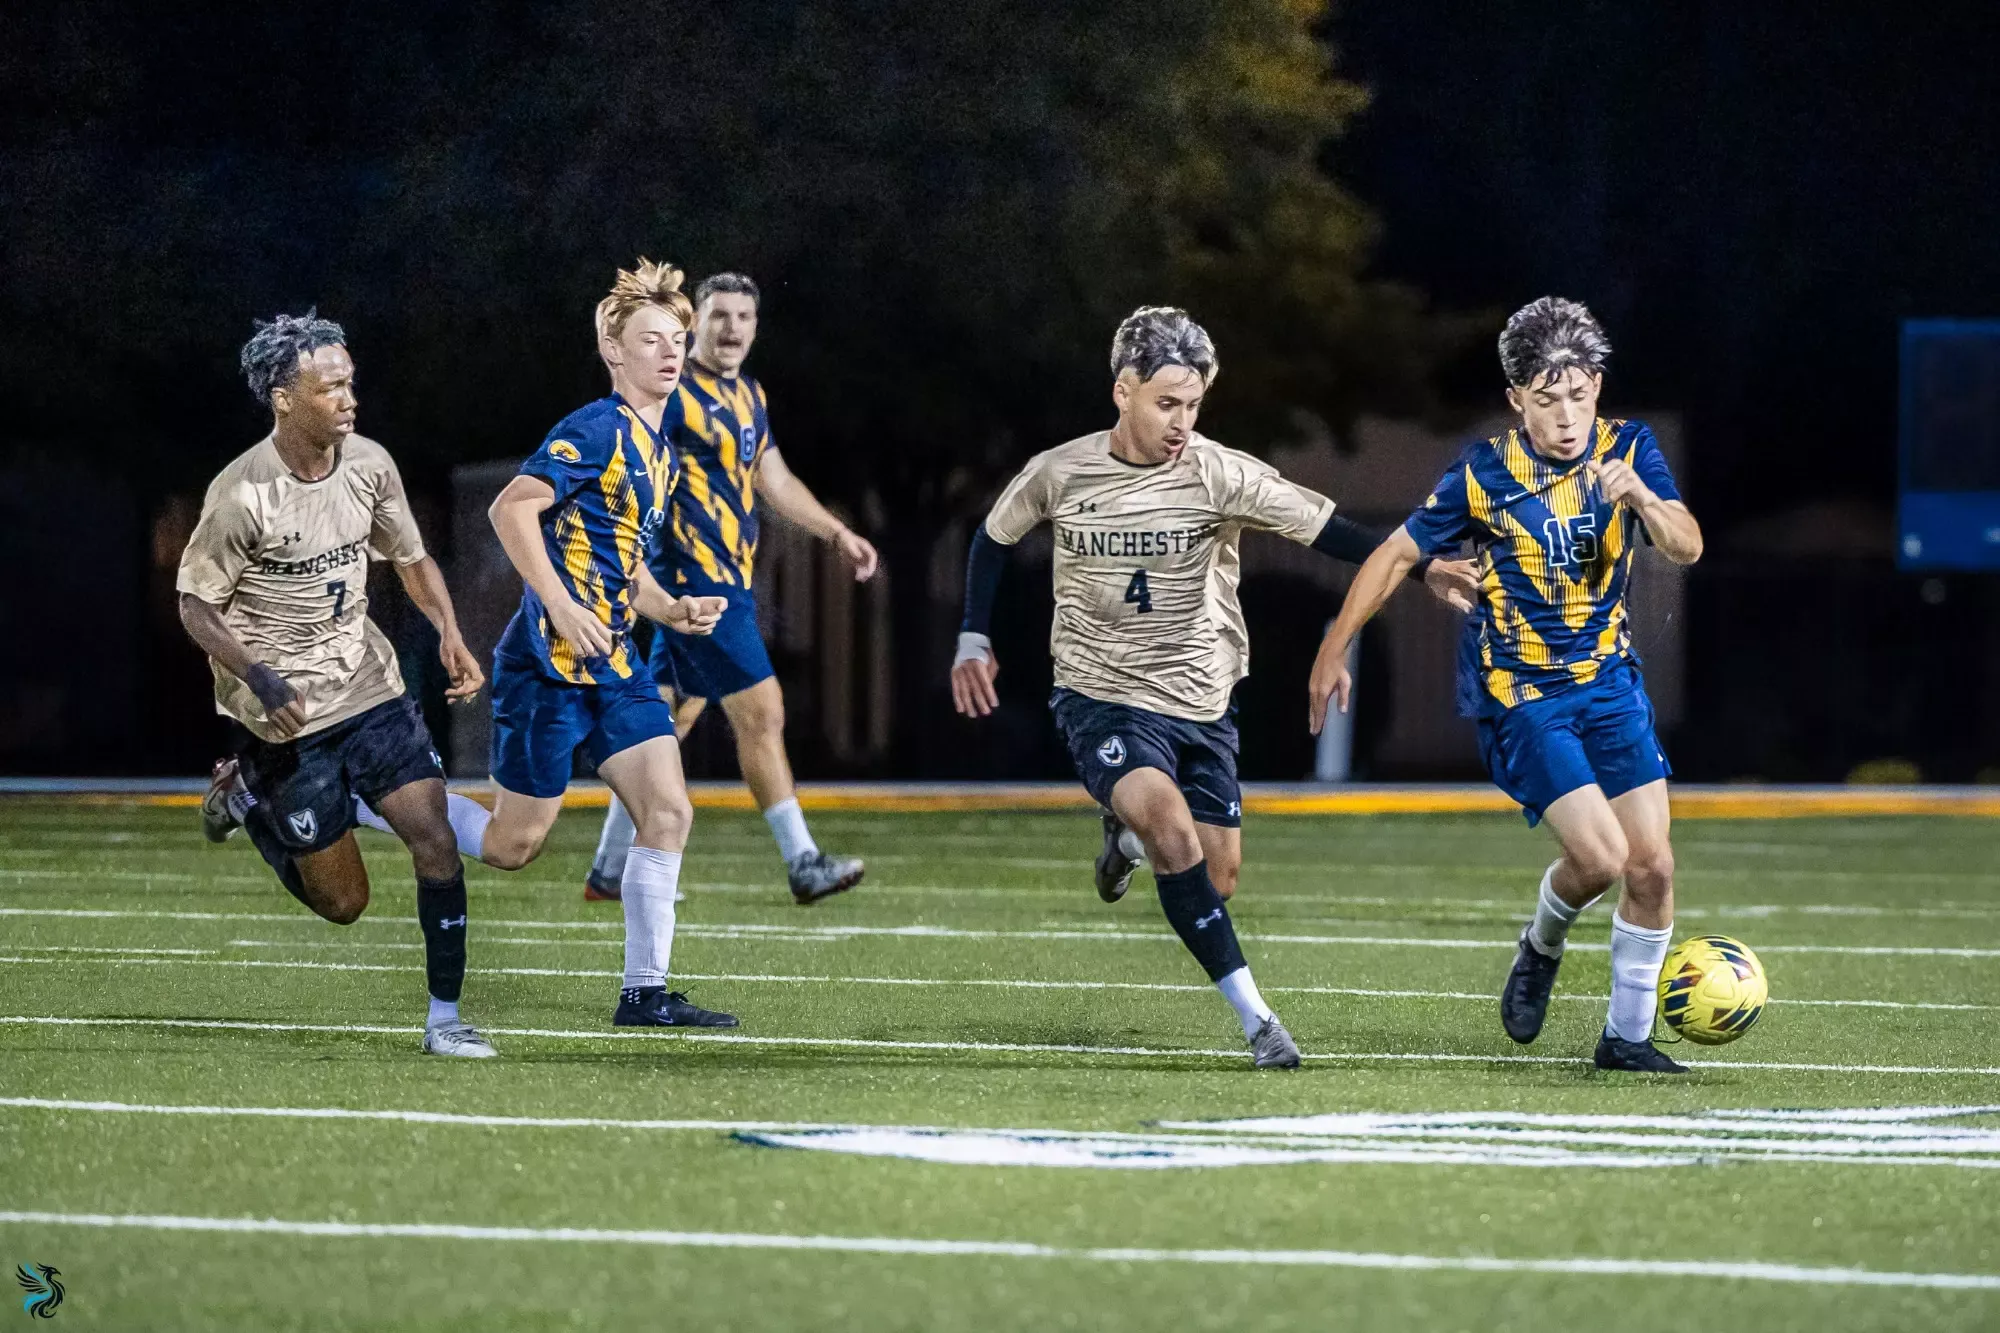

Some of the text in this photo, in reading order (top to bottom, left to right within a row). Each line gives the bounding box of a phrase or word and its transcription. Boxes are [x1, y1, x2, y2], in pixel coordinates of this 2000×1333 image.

[1061, 525, 1213, 557] MANCHESTE
[1542, 513, 1598, 568] 15
[326, 580, 346, 617] 7
[1123, 568, 1153, 614] 4
